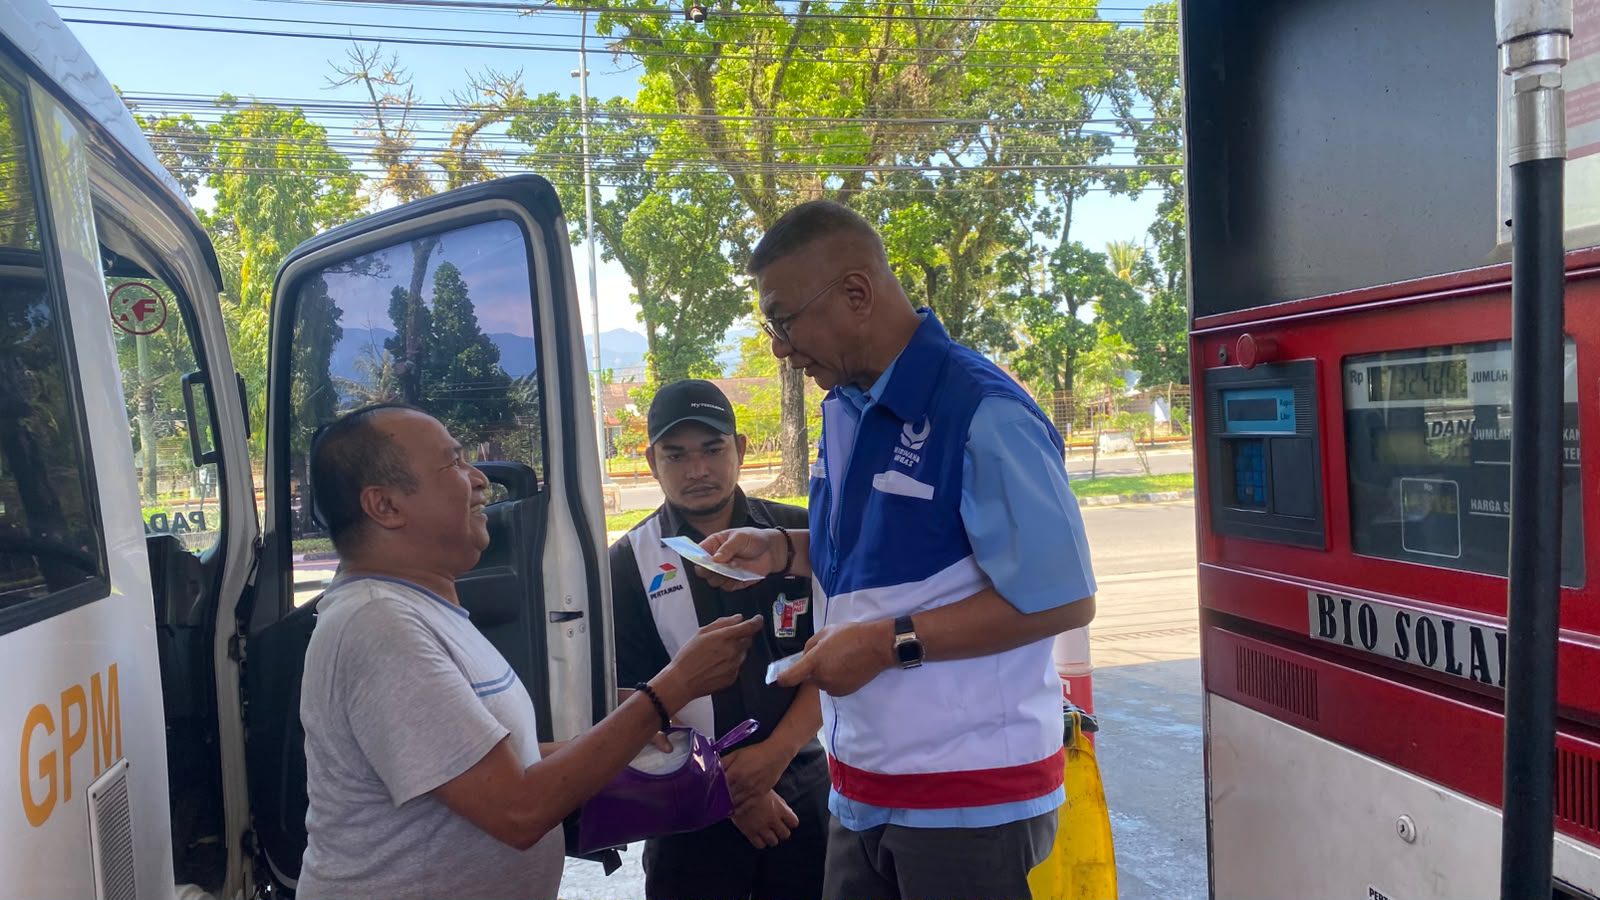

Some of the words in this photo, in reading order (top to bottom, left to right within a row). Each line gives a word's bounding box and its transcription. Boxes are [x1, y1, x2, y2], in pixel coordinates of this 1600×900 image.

[1351, 370, 1363, 385] Rp
[1471, 369, 1508, 384] JUMLAH
[1470, 498, 1501, 513] HARGA
[1503, 501, 1510, 513] S
[1316, 593, 1378, 651] BIO
[20, 662, 122, 828] GPM
